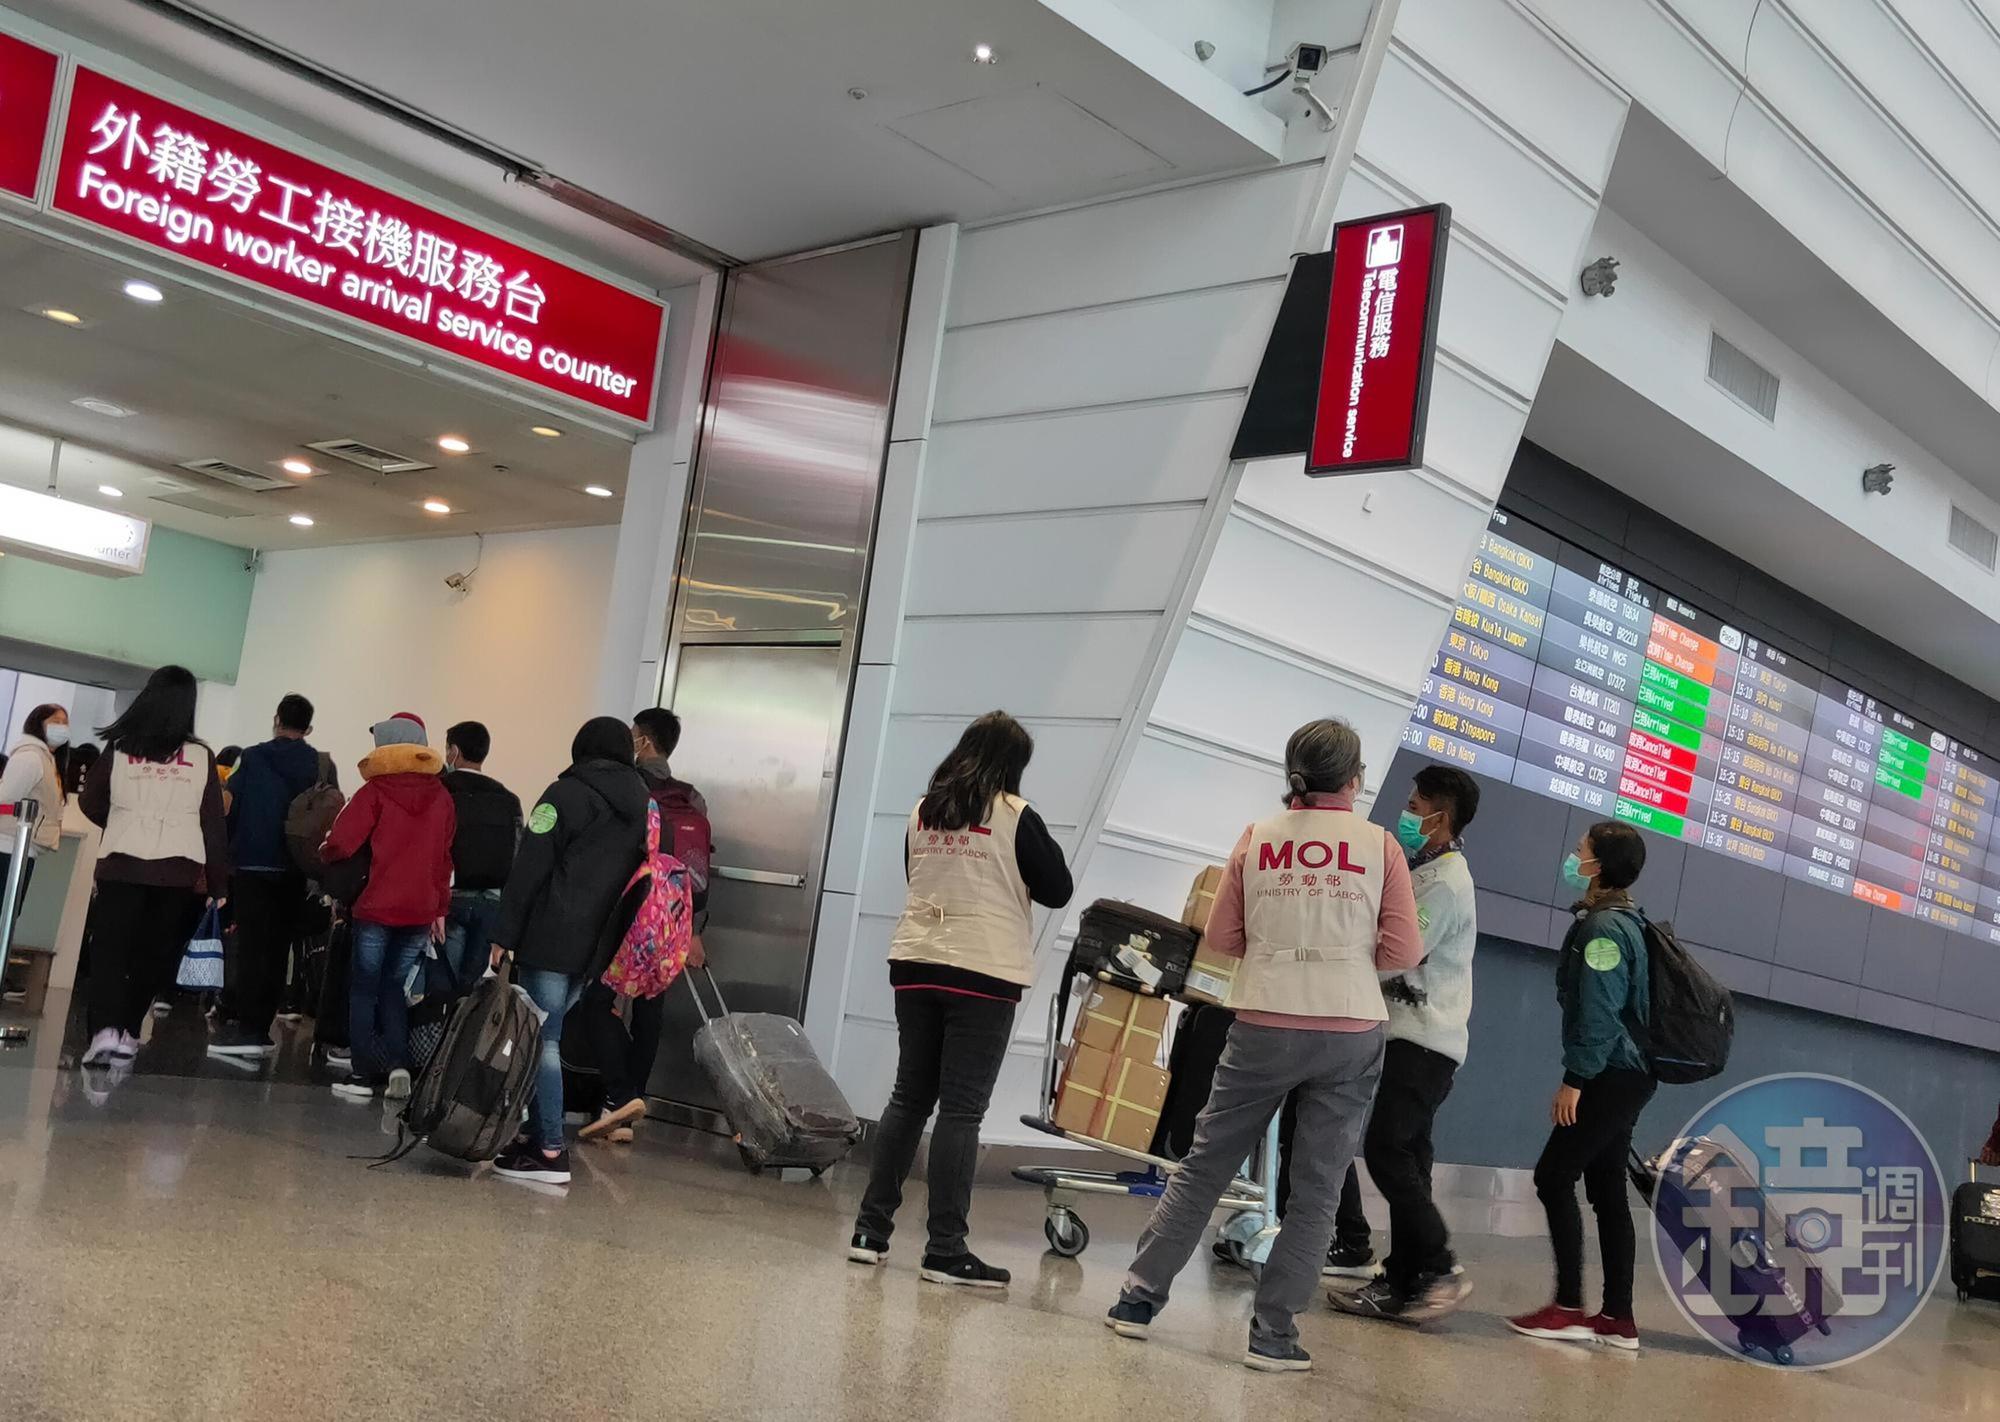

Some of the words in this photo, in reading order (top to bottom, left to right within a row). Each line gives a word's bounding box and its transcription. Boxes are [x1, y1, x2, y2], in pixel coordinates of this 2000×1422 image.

[88, 103, 546, 324] 外籍勞工接機服務台
[78, 161, 214, 244] Foreign
[223, 226, 336, 287] worker
[341, 271, 432, 324] arrival
[437, 307, 533, 361] service
[538, 346, 637, 398] counter
[1369, 267, 1399, 359] 電信服務
[1348, 269, 1377, 406] Telecommunication
[1342, 408, 1358, 458] service
[1497, 597, 1518, 618] Osaka
[1519, 606, 1543, 629] Kansai
[1447, 630, 1467, 652] 東京
[1468, 640, 1490, 662] Tokyo
[1480, 616, 1502, 637] Kuala
[1503, 626, 1527, 649] Lumpur
[1442, 656, 1462, 678] 香港
[1462, 665, 1481, 685] Hong
[1481, 673, 1500, 693] Kong
[1735, 681, 1753, 701] 15:10
[1437, 682, 1457, 703] 香港
[1457, 690, 1475, 710] Hong
[1475, 698, 1494, 717] Kong
[1731, 702, 1749, 722] 15:10
[1432, 707, 1459, 731] 新加坡
[1459, 718, 1496, 745] Singapore
[1727, 723, 1745, 742] 15:15
[1401, 725, 1423, 745] 5:00
[1446, 741, 1457, 757] Da
[1457, 745, 1476, 765] Nang
[1722, 745, 1740, 764] 15:15
[1258, 840, 1366, 875] MOL
[1279, 873, 1342, 887] 勞動部
[1308, 888, 1324, 897] OF
[1328, 890, 1365, 902] LABOR
